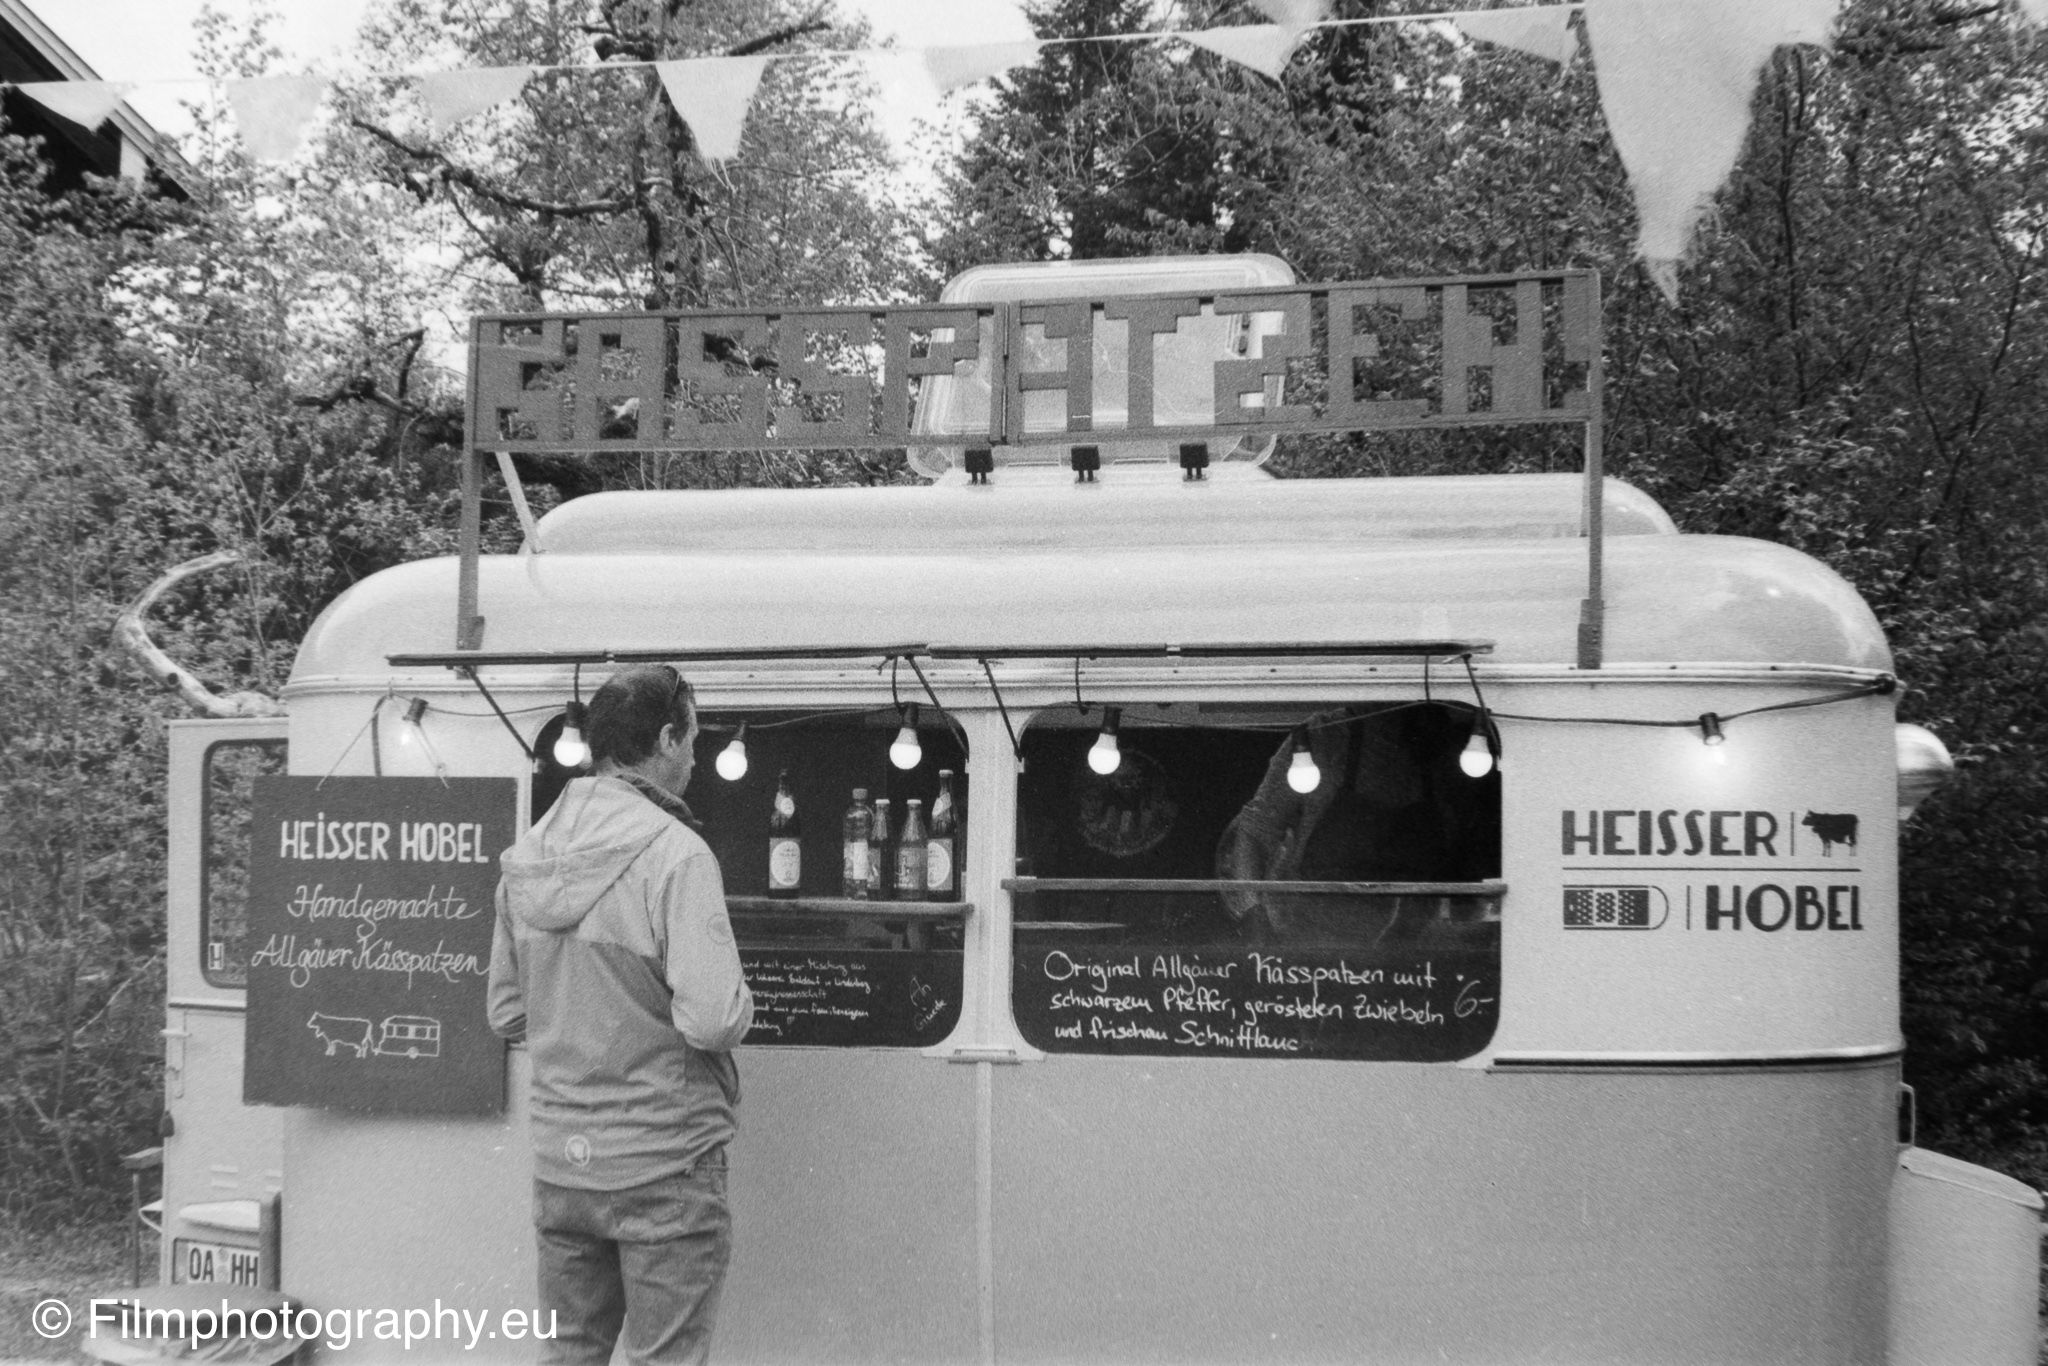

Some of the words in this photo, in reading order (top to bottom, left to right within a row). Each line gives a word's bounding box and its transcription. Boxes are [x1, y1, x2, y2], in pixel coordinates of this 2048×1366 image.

[400, 821, 489, 863] HOBEL
[1562, 809, 1778, 856] HEISSER
[287, 883, 483, 938] Handgemachte
[1706, 883, 1864, 932] HOBEL
[251, 934, 354, 988] Allgäuer
[353, 937, 490, 990] Kässpatzen
[1044, 950, 1140, 992] Original
[1394, 961, 1437, 988] mit
[1049, 988, 1153, 1012] schwarzem
[1163, 986, 1236, 1019] Pfeffer,
[1245, 995, 1343, 1026] gerösteten
[1353, 994, 1444, 1026] Zwiebeln
[1055, 1020, 1083, 1038] und
[190, 1247, 214, 1282] OA
[231, 1253, 259, 1286] HH
